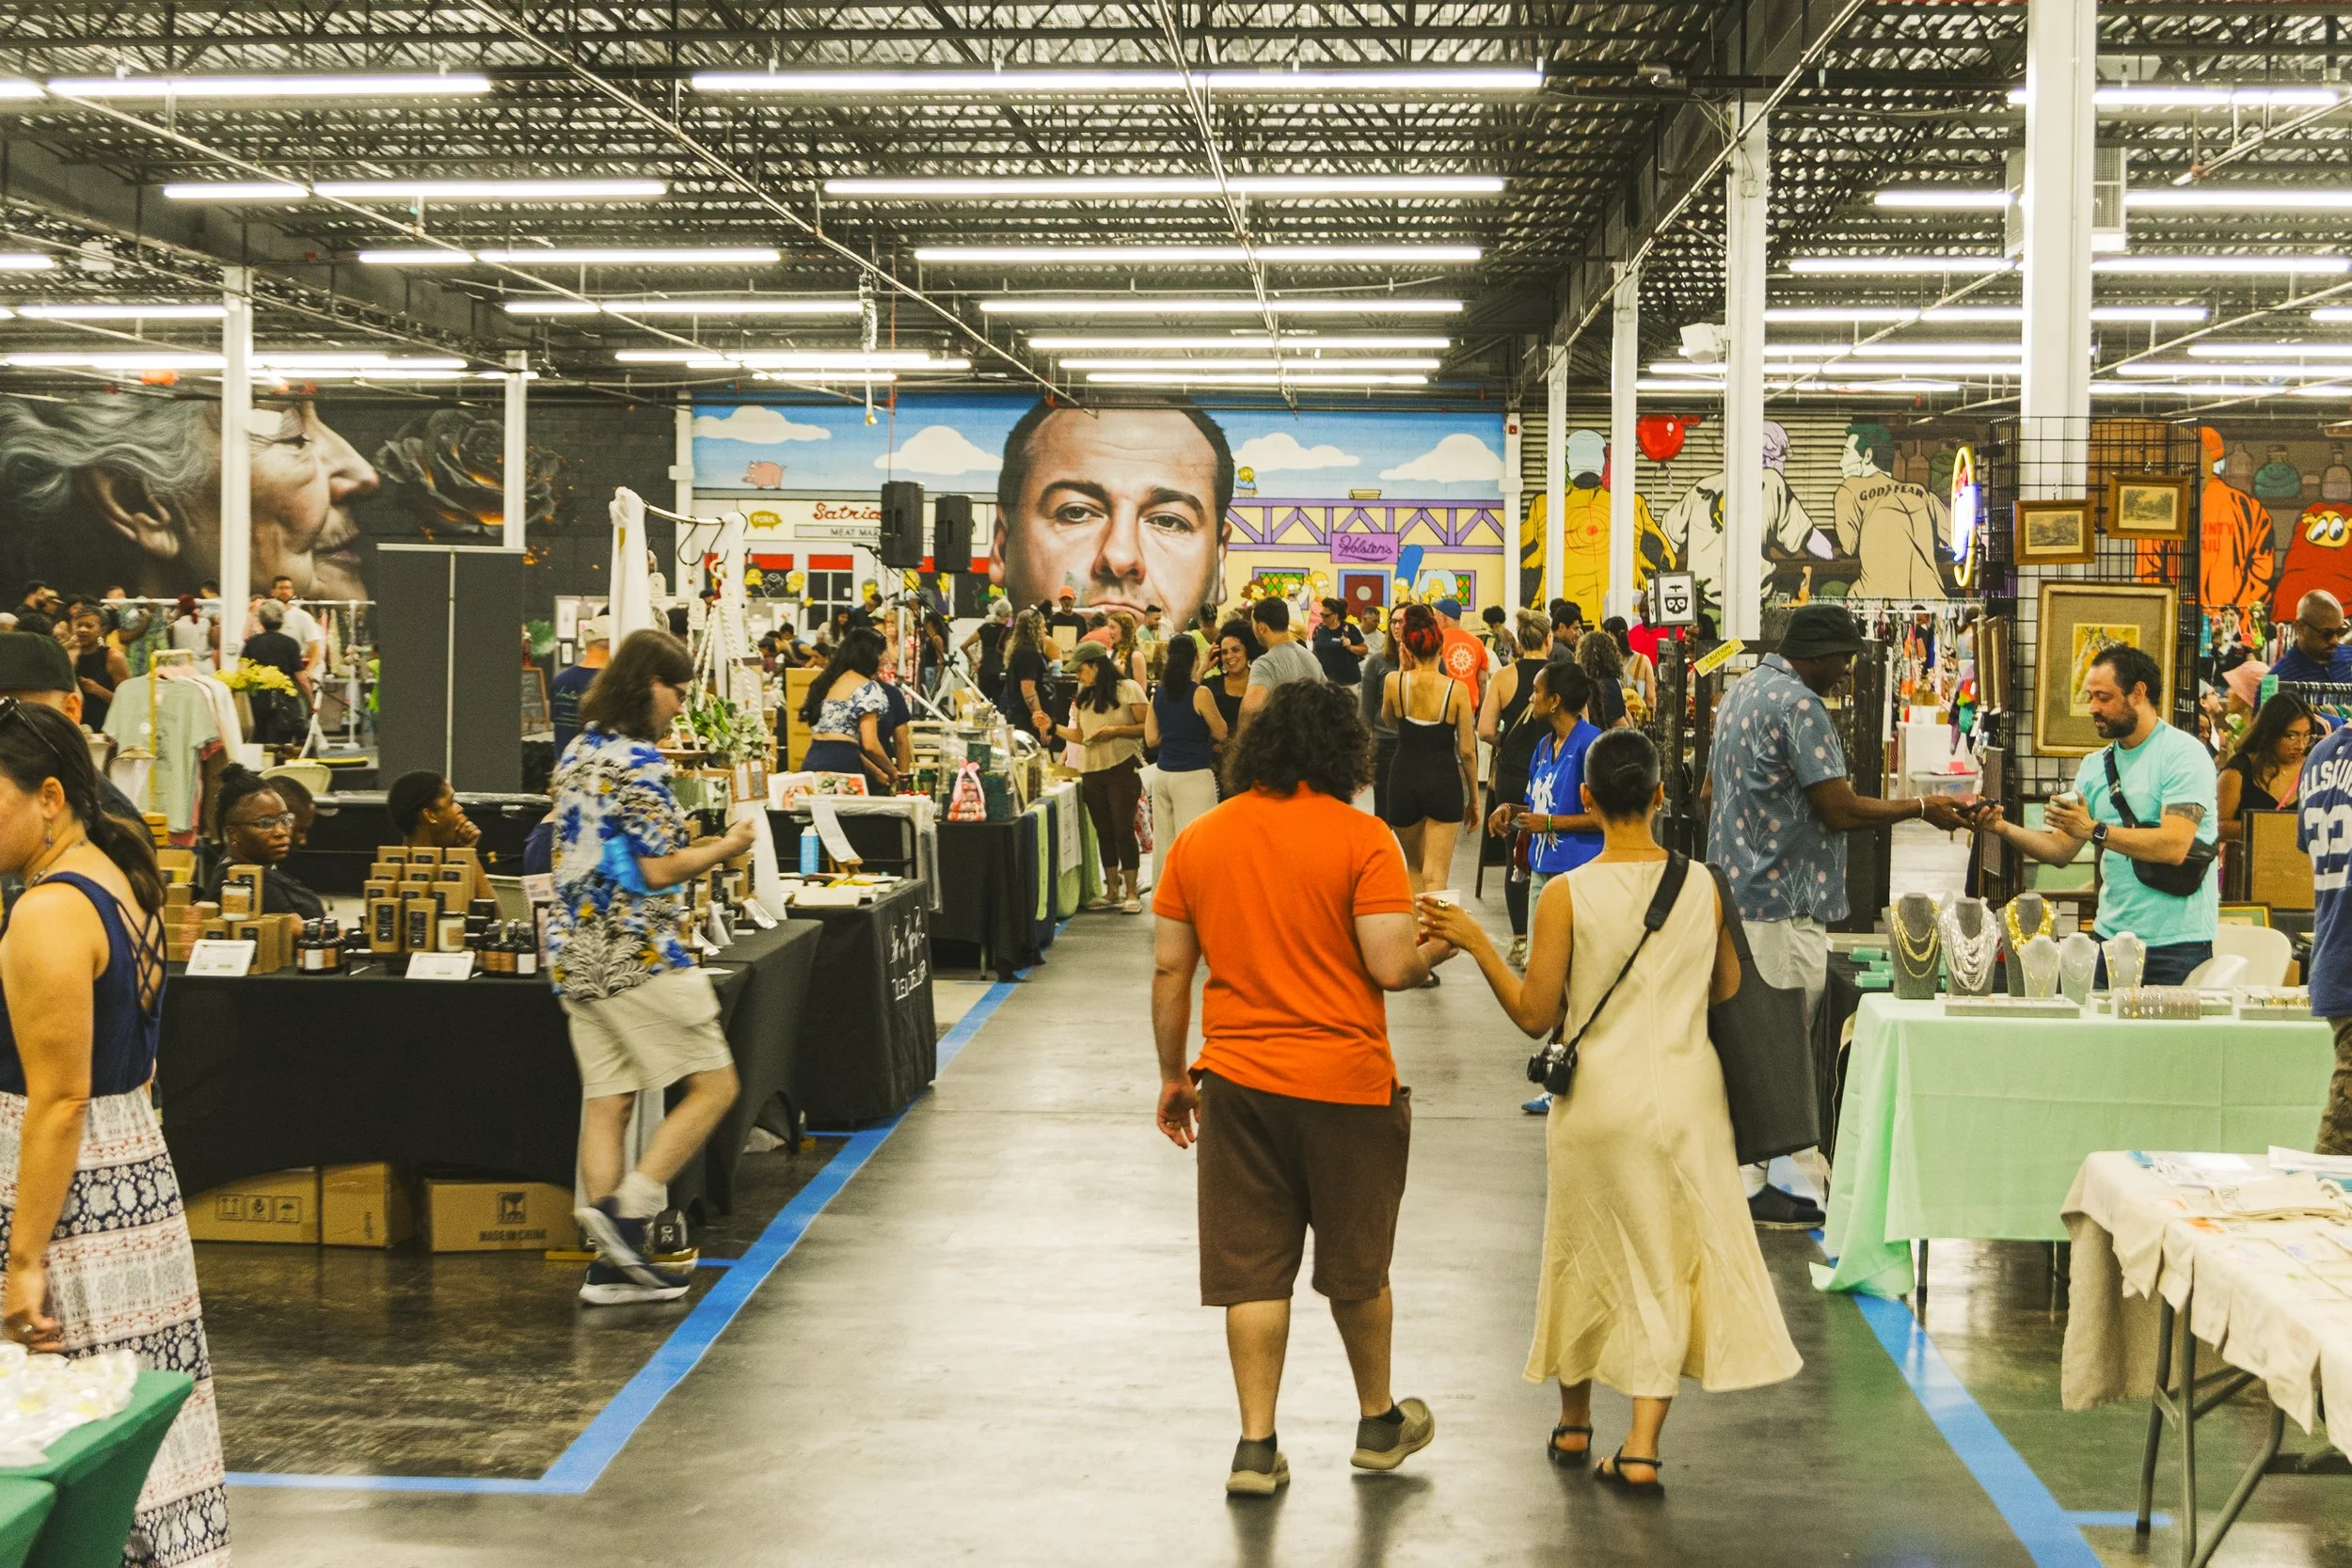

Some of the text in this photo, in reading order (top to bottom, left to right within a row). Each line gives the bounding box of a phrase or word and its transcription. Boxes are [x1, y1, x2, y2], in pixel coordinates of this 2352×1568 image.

[1859, 484, 1924, 501] GOD FEAR
[830, 529, 854, 537] MEAT
[1338, 534, 1393, 556] Holsten's
[1705, 644, 1731, 663] CAUTION
